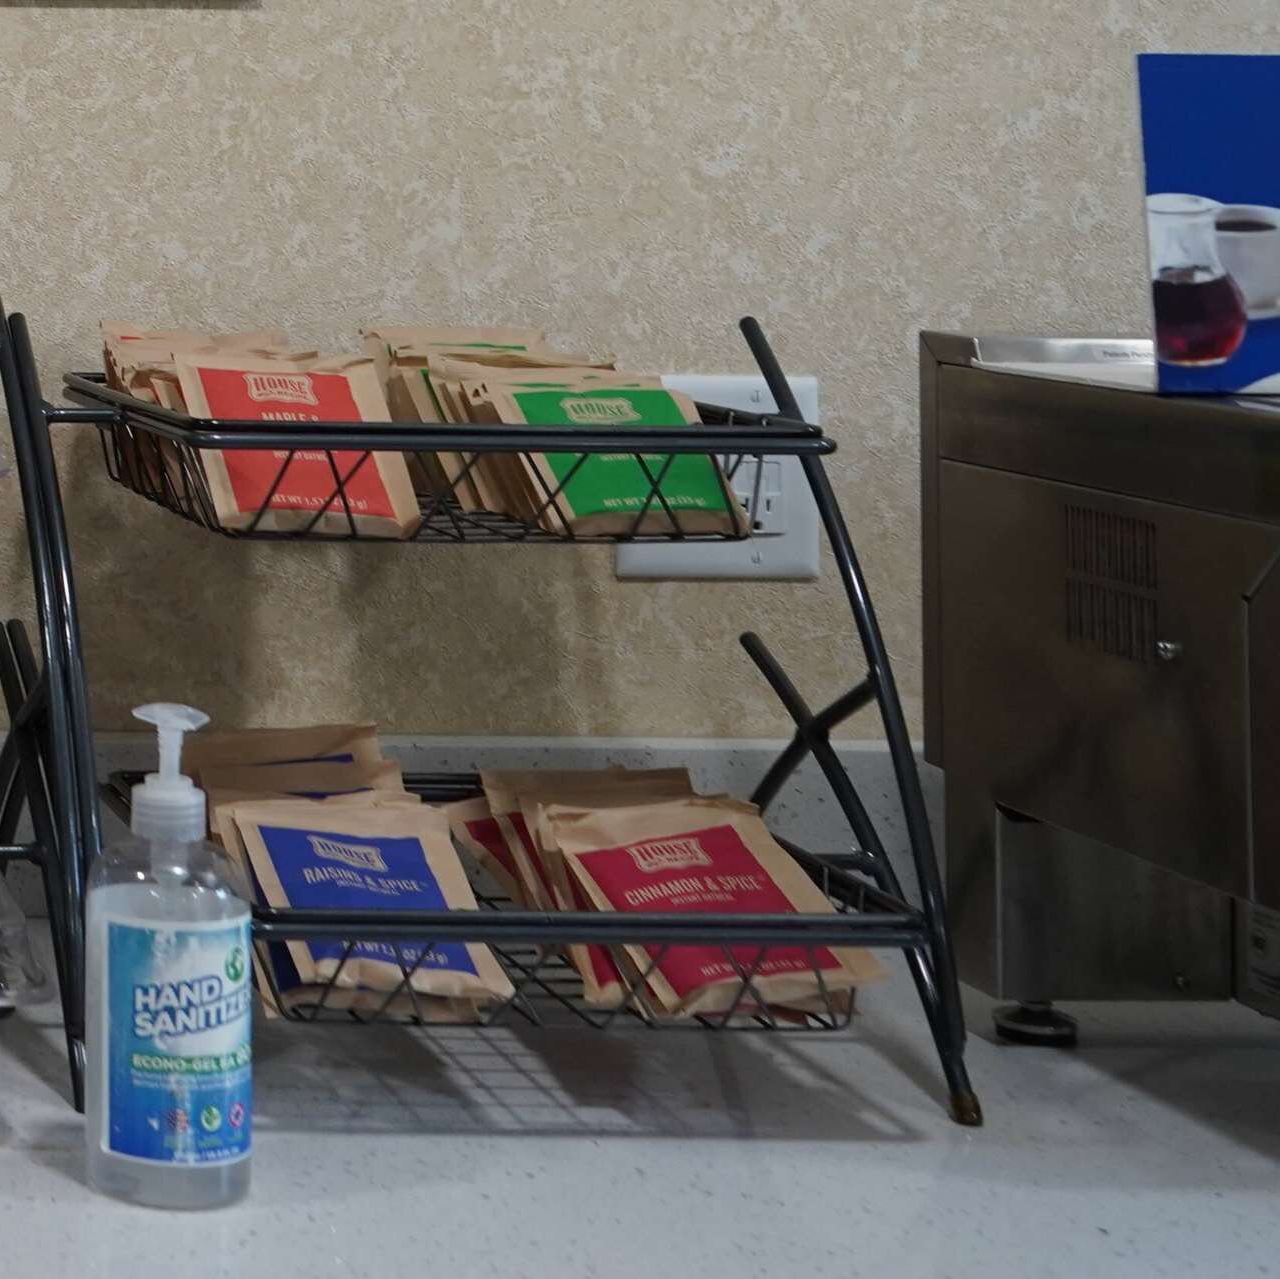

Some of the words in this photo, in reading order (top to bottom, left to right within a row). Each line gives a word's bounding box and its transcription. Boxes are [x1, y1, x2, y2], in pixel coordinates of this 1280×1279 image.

[252, 377, 308, 394] HOUSE
[570, 402, 626, 417] HOUSE
[317, 841, 375, 866] HOUSE
[635, 841, 698, 862] HOUSE
[303, 867, 362, 885] RAISINS
[364, 875, 378, 888] &
[378, 877, 423, 893] SPICE
[624, 876, 705, 907] CINNAMON
[705, 876, 719, 891] &
[718, 873, 762, 891] SPICE
[133, 975, 222, 1012] HAND
